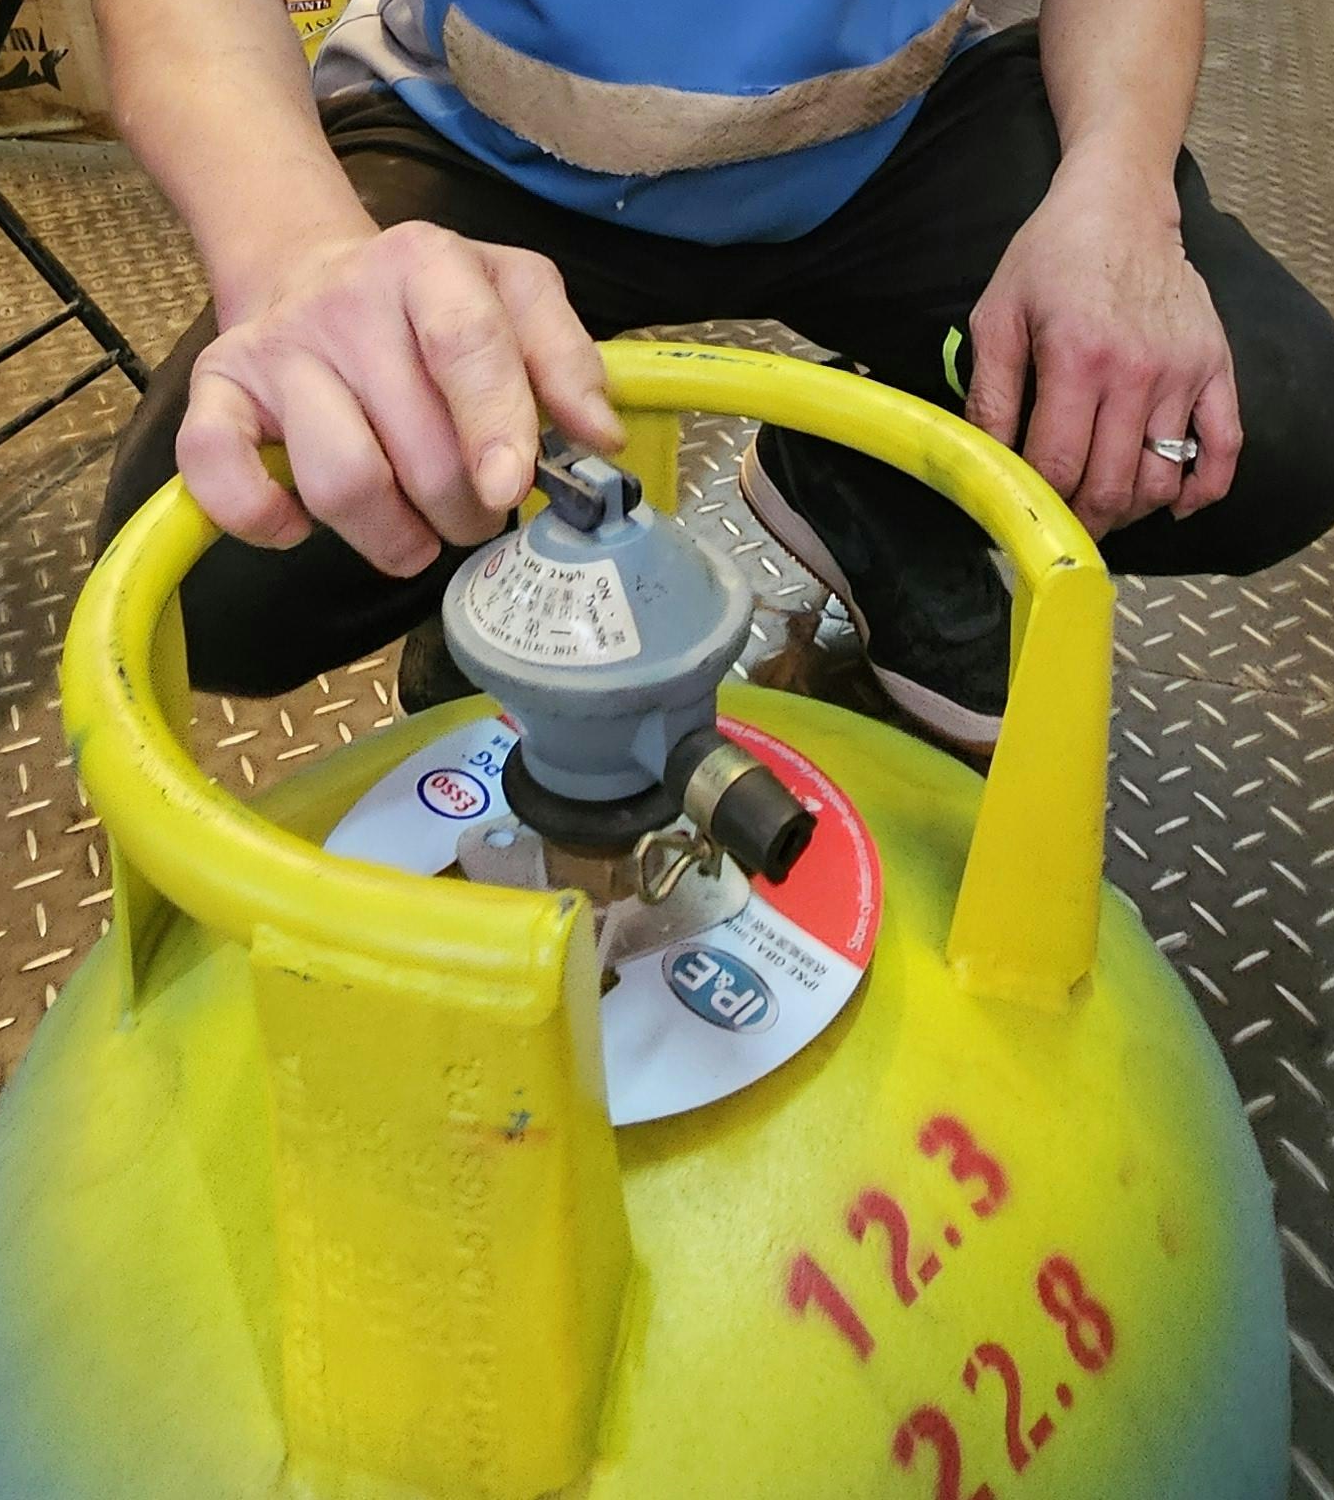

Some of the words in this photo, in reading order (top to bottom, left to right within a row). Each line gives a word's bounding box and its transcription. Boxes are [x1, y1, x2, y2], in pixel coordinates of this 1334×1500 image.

[674, 951, 766, 1026] IP&E
[785, 1114, 1010, 1363] 12.3
[892, 1254, 1115, 1500] 22.8
